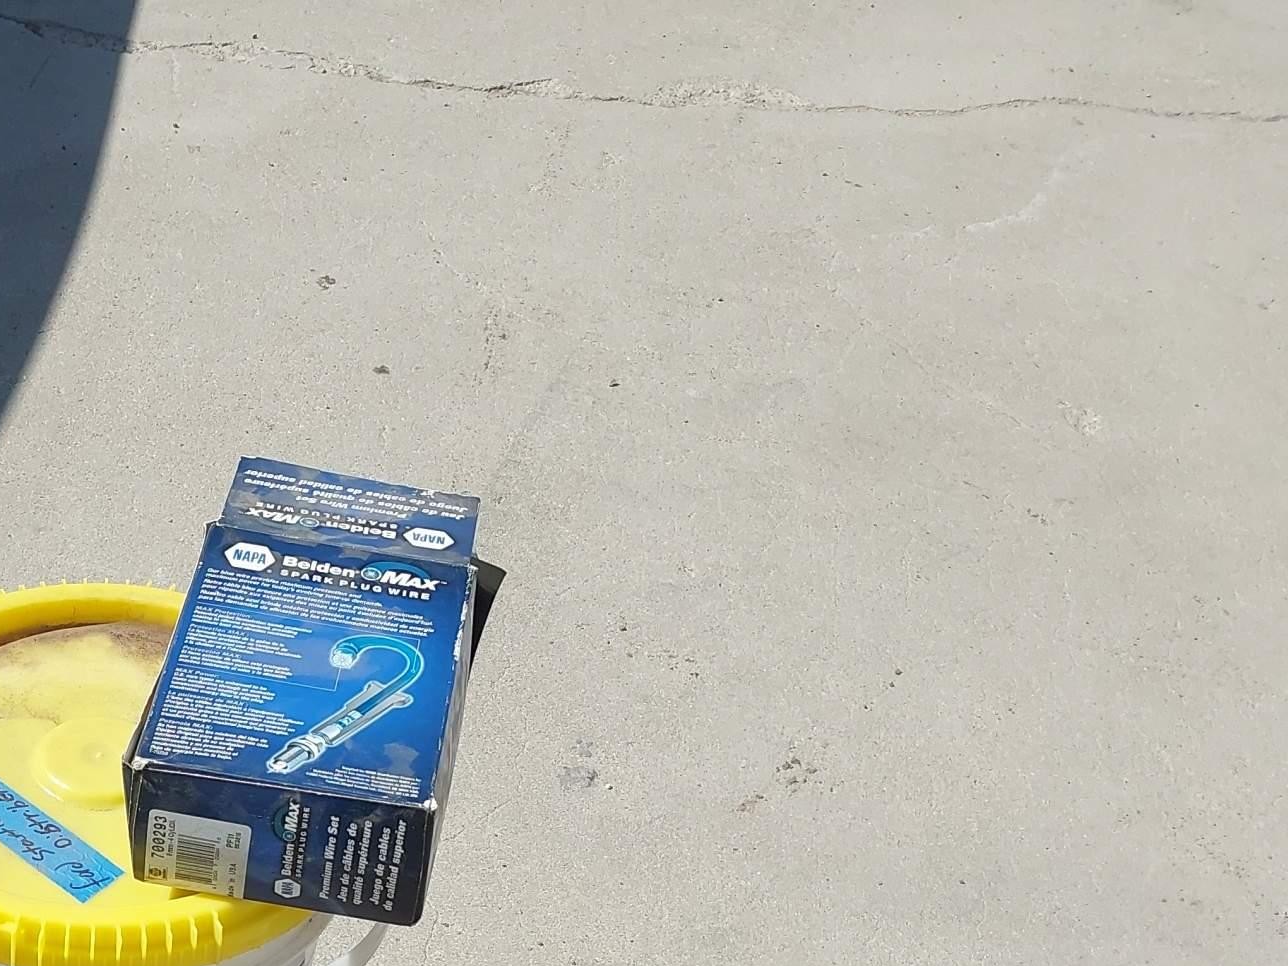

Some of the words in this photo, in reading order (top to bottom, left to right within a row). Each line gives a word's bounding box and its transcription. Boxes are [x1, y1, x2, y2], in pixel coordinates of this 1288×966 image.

[244, 469, 295, 482] superior
[298, 479, 343, 490] calidad
[295, 495, 317, 503] Set
[319, 499, 347, 508] Wire
[365, 491, 405, 501] cables
[245, 507, 300, 524] MAX
[254, 500, 294, 512] WIRE
[299, 508, 340, 520] PLUG
[350, 504, 407, 518] Premium
[429, 501, 468, 512] Juego
[325, 520, 396, 539] Belden
[346, 516, 397, 529] SPARK
[412, 532, 445, 544] NAPA
[232, 548, 266, 564] NAPA
[282, 555, 355, 577] Belden
[379, 570, 439, 590] MAX
[279, 568, 333, 584] SPARK
[339, 578, 382, 592] PLUG
[387, 587, 430, 600] WIRE
[284, 802, 300, 832] MAX
[301, 806, 310, 828] WIRE
[327, 815, 339, 834] Set
[150, 815, 166, 858] 700293
[346, 822, 357, 836] de
[298, 830, 307, 852] PLUG
[324, 836, 336, 859] Wire
[357, 820, 372, 874] supérieure
[377, 827, 390, 861] cables
[392, 819, 406, 864] superior
[281, 843, 294, 875] Belden
[341, 838, 355, 871] câbles
[295, 854, 304, 877] SPARK
[373, 863, 385, 876] de
[319, 861, 332, 899] Premium
[339, 873, 350, 884] de
[385, 865, 398, 898] calidad
[337, 886, 348, 901] Jeu
[352, 876, 363, 904] qualité
[369, 878, 383, 904] Juego
[382, 900, 393, 910] de
